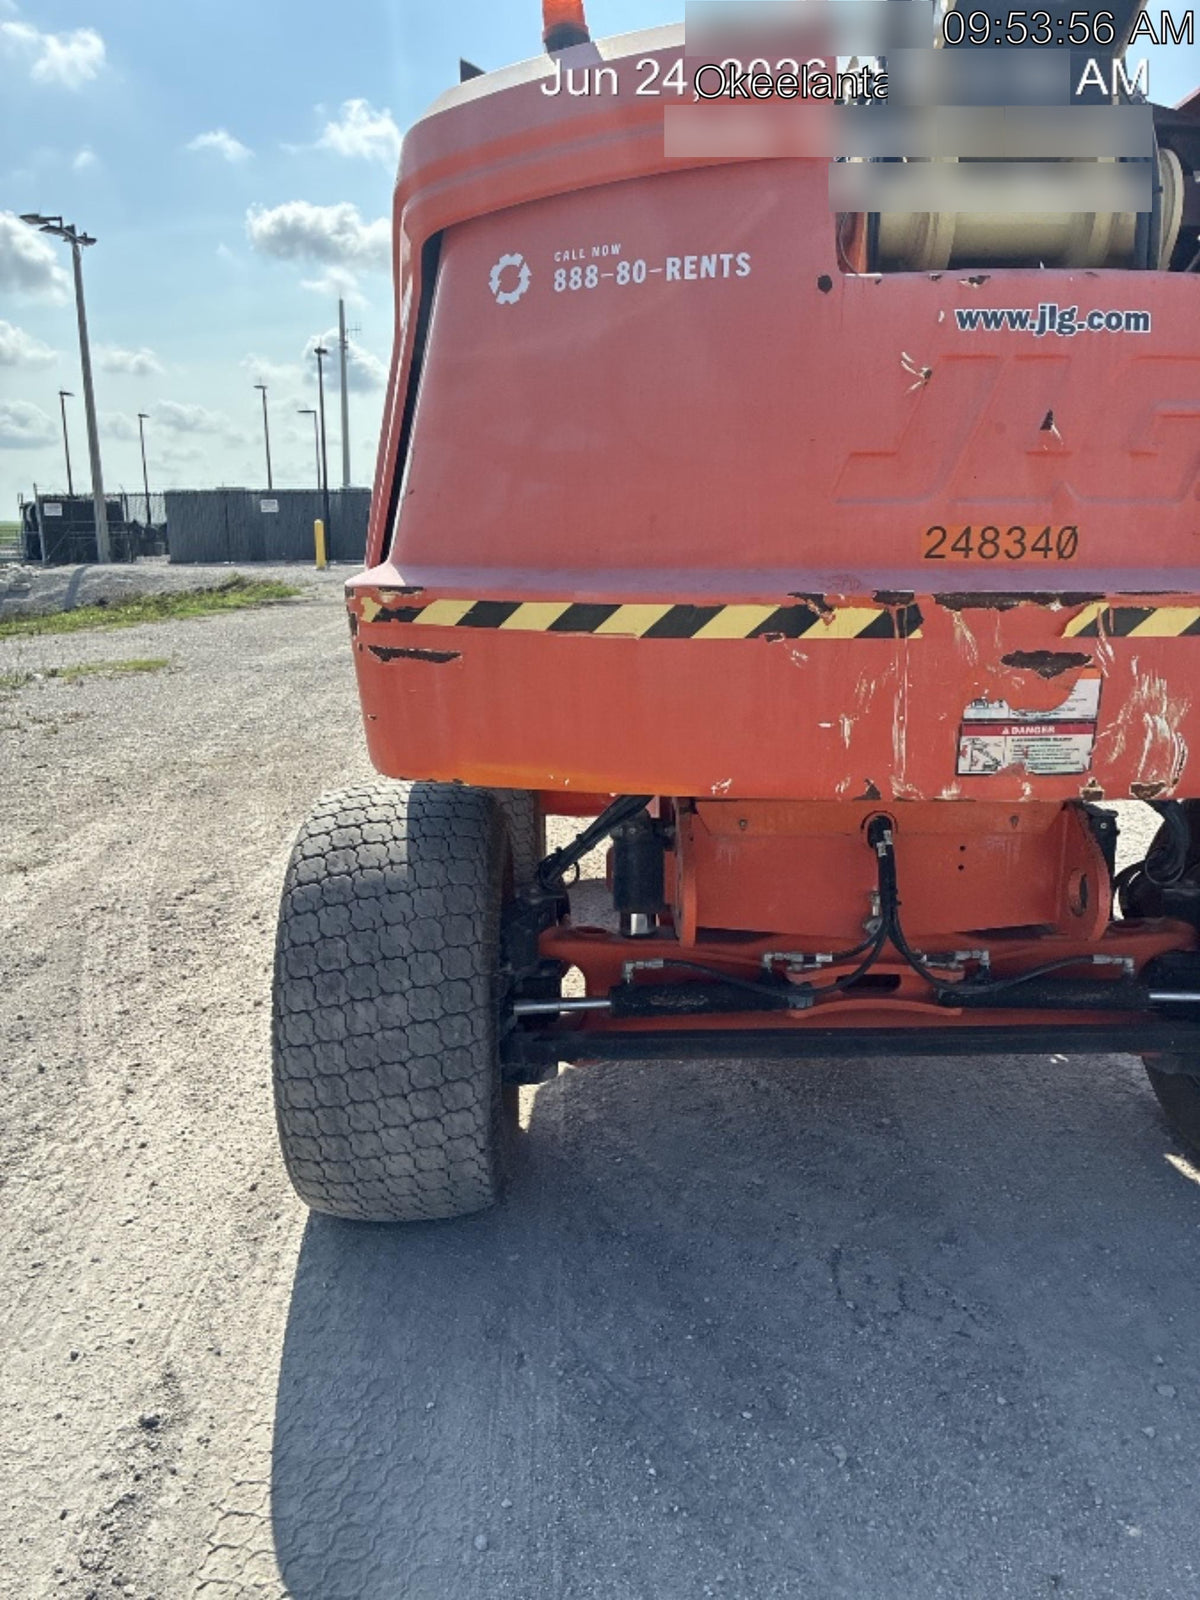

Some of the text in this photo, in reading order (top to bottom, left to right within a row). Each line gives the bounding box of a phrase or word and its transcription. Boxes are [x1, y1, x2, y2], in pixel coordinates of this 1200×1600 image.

[554, 243, 622, 262] CALL NOW
[553, 252, 751, 293] 888-80-RENTS
[954, 303, 1152, 337] www.jlg.com
[1011, 725, 1056, 735] DANGER
